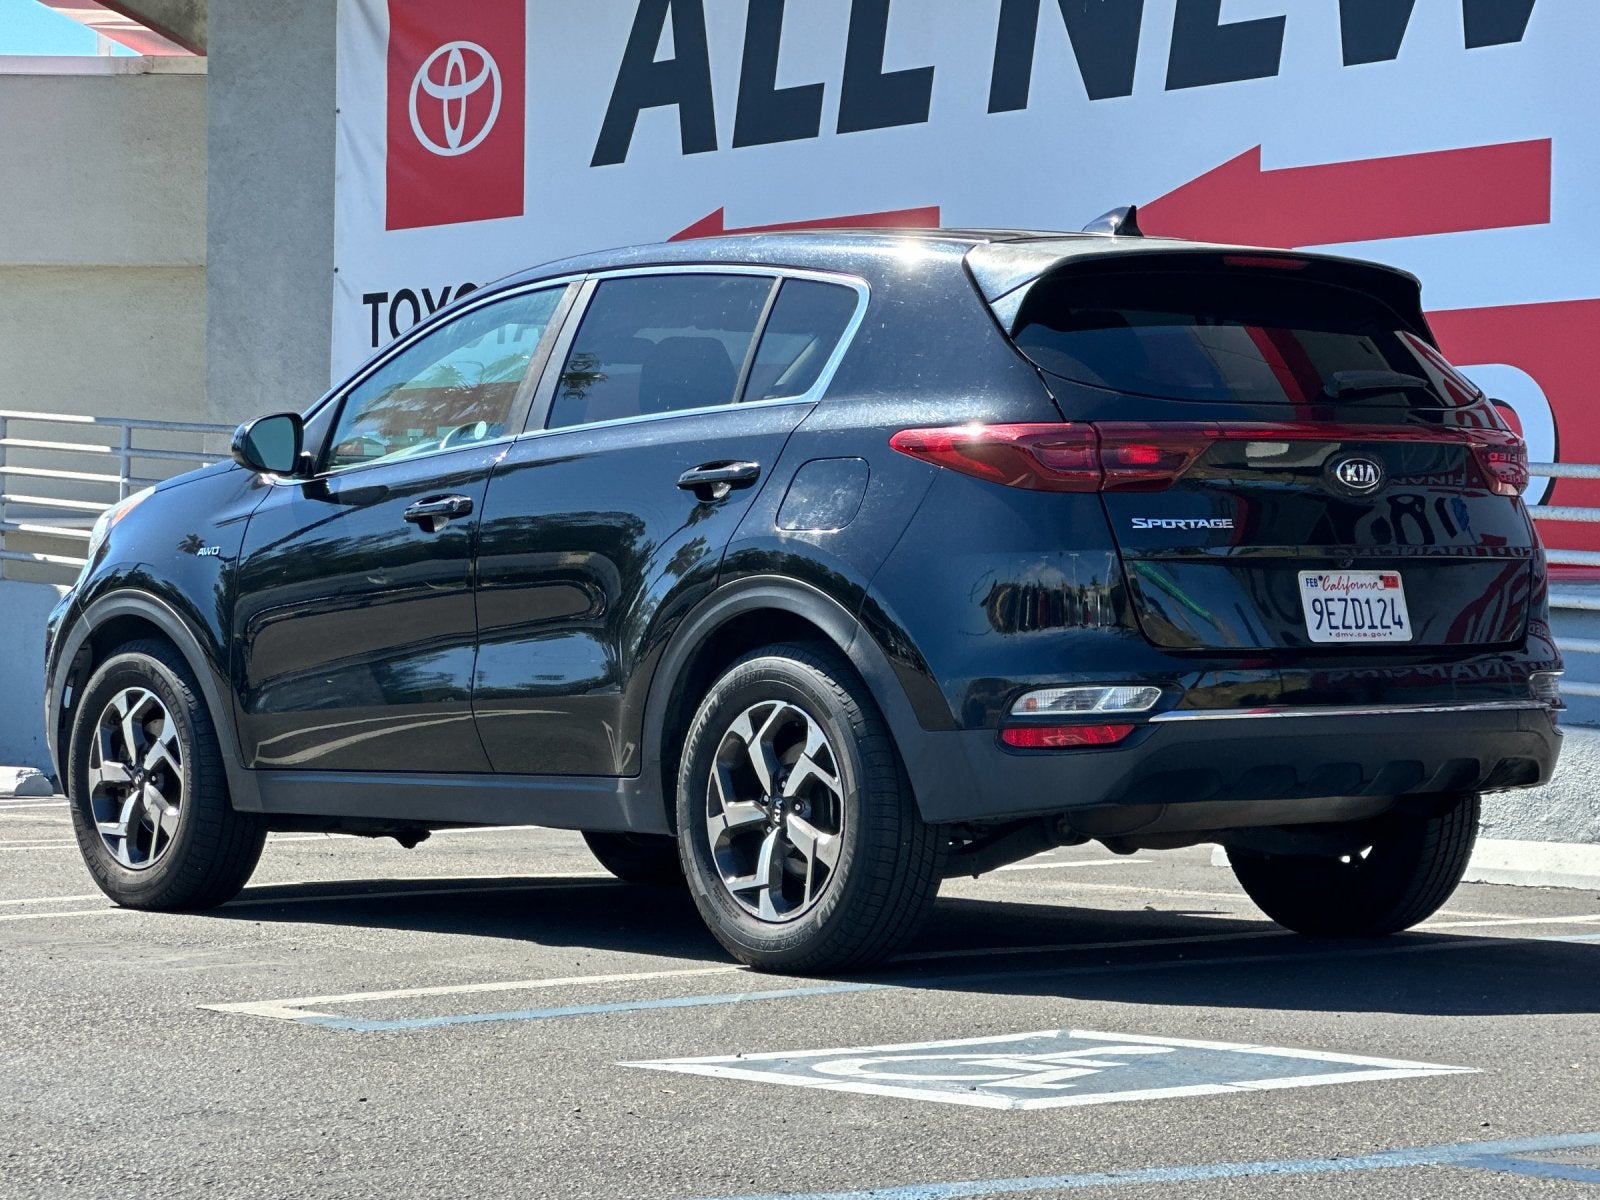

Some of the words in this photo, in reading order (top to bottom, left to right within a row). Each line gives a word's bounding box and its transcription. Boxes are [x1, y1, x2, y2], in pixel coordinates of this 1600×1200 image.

[1346, 464, 1376, 483] KIA
[1131, 517, 1235, 530] SPORTAGE
[197, 546, 220, 556] AWD
[1305, 577, 1319, 588] FEB
[1322, 575, 1379, 596] California
[1311, 597, 1404, 631] 9EZD124
[773, 800, 783, 822] KIA
